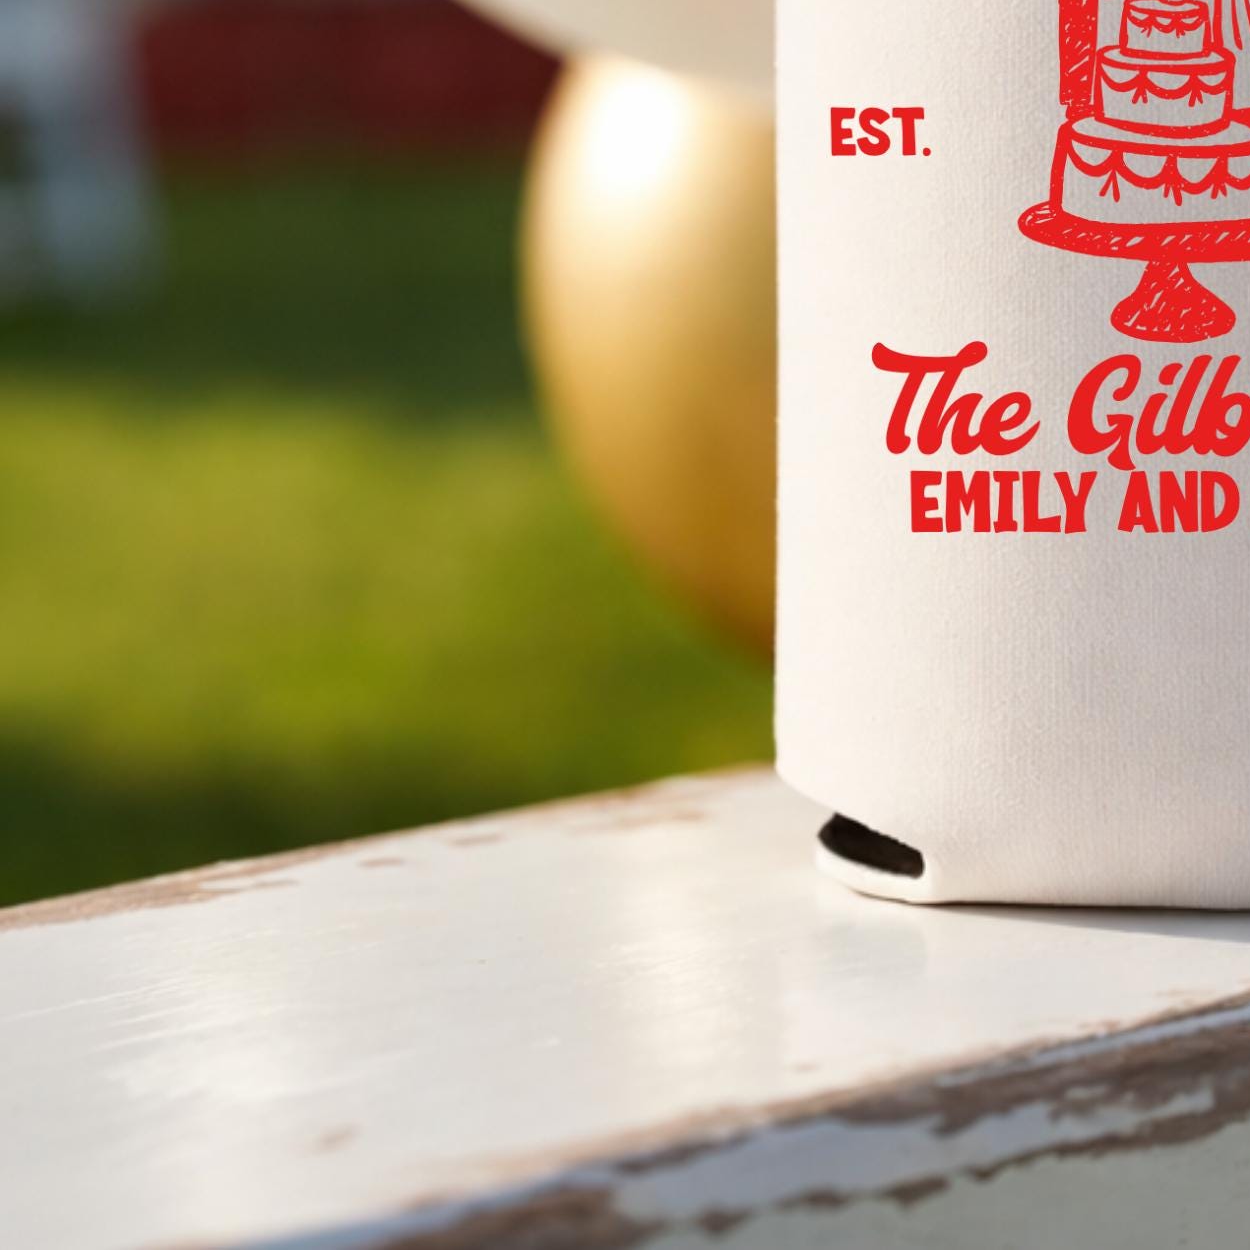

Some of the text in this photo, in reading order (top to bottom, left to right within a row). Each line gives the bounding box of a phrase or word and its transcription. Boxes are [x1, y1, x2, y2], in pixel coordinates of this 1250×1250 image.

[830, 107, 931, 157] EST.
[872, 341, 1040, 457] The
[910, 471, 1098, 534] EMILY
[1118, 471, 1240, 534] AND
